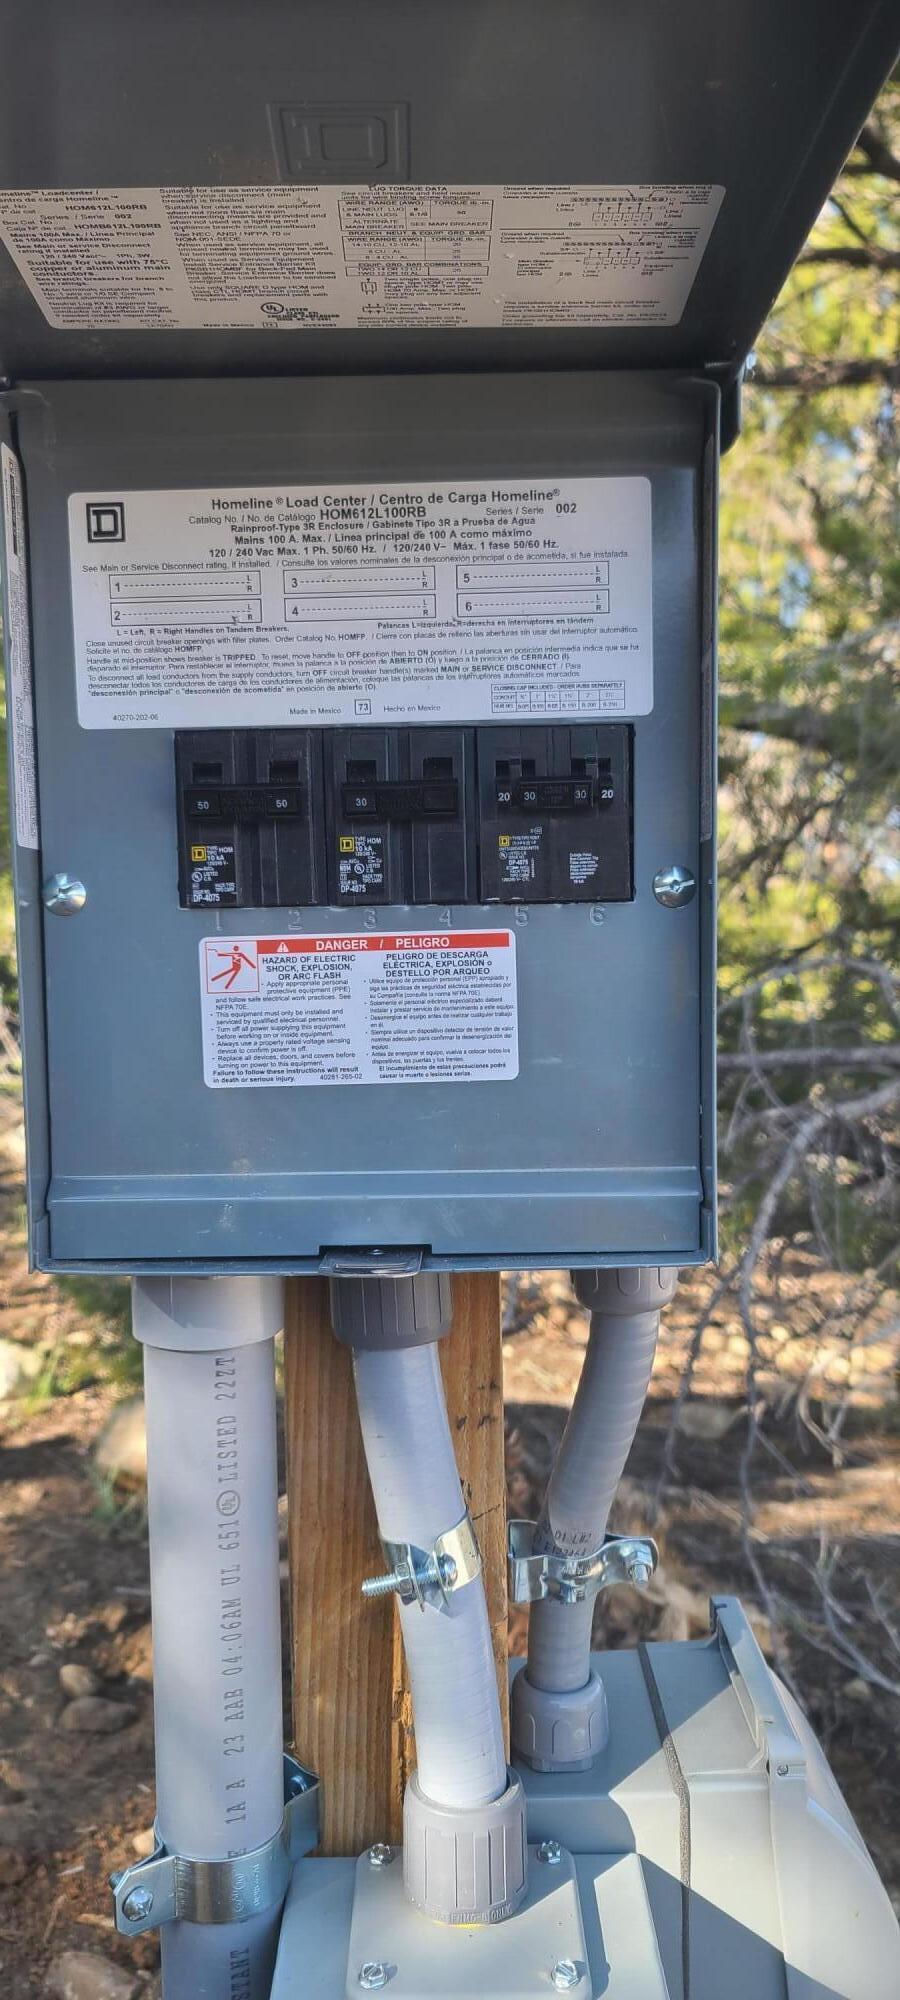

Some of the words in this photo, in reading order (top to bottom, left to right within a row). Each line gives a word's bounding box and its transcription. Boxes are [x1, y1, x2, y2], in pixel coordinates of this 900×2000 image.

[286, 495, 319, 509] Load
[323, 494, 366, 510] Center
[379, 492, 423, 509] Centro
[427, 492, 444, 504] de
[447, 490, 487, 506] Carga
[188, 515, 222, 526] Catalog
[224, 514, 239, 523] No.
[247, 514, 263, 523] No.
[263, 514, 275, 522] de
[277, 512, 316, 524] Catálogo
[319, 507, 426, 523] HOM612L100RB
[486, 506, 513, 516] Series
[521, 505, 544, 515] Serie
[555, 503, 577, 514] 002
[231, 522, 301, 535] Rainproof-Type
[303, 521, 316, 531] 3R
[318, 520, 364, 530] Enclosure
[372, 519, 414, 528] Gabinete
[415, 519, 436, 529] Tipo
[438, 518, 451, 527] 3R
[461, 517, 495, 526] Prueba
[497, 516, 508, 525] de
[511, 516, 536, 526] Agua
[234, 535, 265, 545] Mains
[268, 534, 286, 544] 100
[301, 533, 325, 543] Max.
[365, 531, 410, 544] principal
[413, 530, 425, 540] de
[429, 530, 446, 539] 100
[449, 530, 457, 539] A
[491, 528, 532, 542] máximo
[209, 548, 226, 558] 120
[235, 547, 253, 557] 240
[254, 547, 274, 556] Vac
[276, 546, 300, 556] Max.
[303, 546, 308, 555] 1
[312, 545, 329, 555] Ph.
[331, 544, 358, 554] 50/60
[361, 544, 376, 553] Hz.
[393, 542, 431, 552] 120/240
[453, 541, 476, 551] Máx.
[480, 541, 484, 550] 1
[488, 541, 510, 550] fase
[513, 539, 540, 549] 50/60
[542, 539, 559, 548] Hz.
[131, 563, 159, 571] Service
[161, 562, 203, 570] Disconnect
[292, 578, 298, 588] 3
[464, 573, 470, 583] 5
[115, 583, 120, 592] 1
[292, 607, 299, 616] 4
[465, 602, 472, 612] 6
[114, 611, 121, 620] 2
[358, 703, 369, 712] 73
[498, 792, 510, 801] 20
[524, 792, 535, 800] 30
[575, 791, 587, 799] 30
[601, 790, 613, 798] 20
[197, 801, 209, 810] 50
[276, 800, 288, 808] 50
[356, 798, 367, 807] 30
[439, 909, 452, 926] 4
[515, 906, 528, 926] 5
[590, 906, 605, 926] 6
[316, 939, 368, 951] DANGER
[380, 939, 384, 948] /
[395, 937, 450, 950] PELIGRO
[262, 956, 298, 965] HAZARD
[313, 954, 356, 963] ELECTRIC
[386, 952, 424, 962] PELIGRO
[440, 951, 489, 960] DESCARGA
[266, 965, 299, 974] SHOCK,
[301, 963, 353, 972] EXPLOSION,
[435, 959, 485, 968] EXPLOSIÓN
[386, 969, 431, 978] DESTELLO
[432, 968, 451, 977] POR
[452, 968, 491, 976] ARQUEO
[216, 1415, 238, 1483] LISTED
[218, 1520, 240, 1551] 651
[221, 1564, 240, 1586] UL
[220, 1598, 242, 1676] 04:06AM
[224, 1688, 244, 1722] AAB
[223, 1735, 245, 1757] 23
[225, 1779, 245, 1790] A
